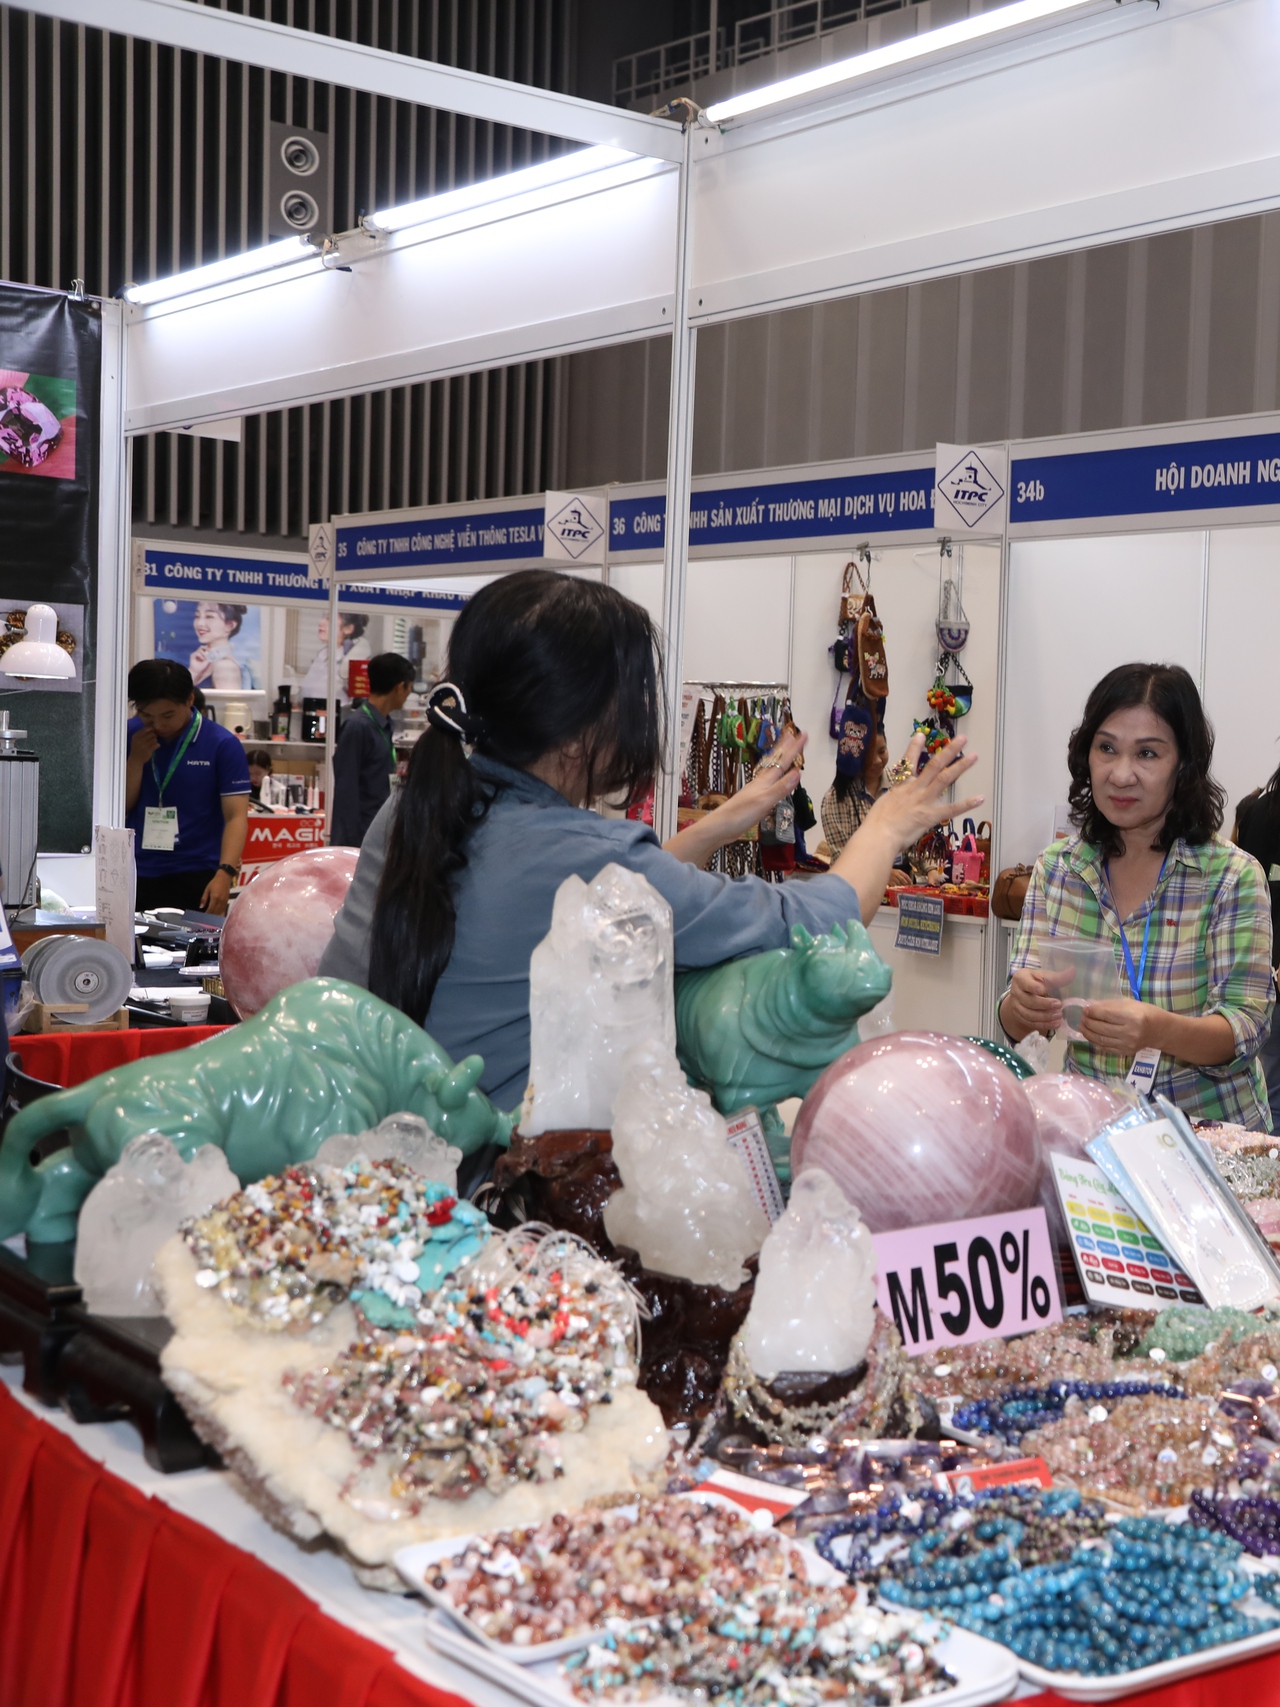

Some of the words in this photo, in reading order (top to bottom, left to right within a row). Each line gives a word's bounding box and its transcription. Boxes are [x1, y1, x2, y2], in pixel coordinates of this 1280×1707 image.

[1016, 480, 1045, 504] 34b
[1155, 462, 1185, 495] HỘI
[1190, 461, 1251, 488] DOANH
[953, 489, 989, 502] ITPC
[612, 517, 626, 536] 36
[633, 511, 661, 534] CÔNG
[689, 510, 708, 530] NHH
[710, 501, 733, 527] SẢN
[735, 497, 764, 526] XUẤT
[768, 498, 815, 523] THƯƠNG
[817, 497, 841, 521] MẠI
[844, 494, 874, 520] DỊCH
[878, 492, 895, 518] VỤ
[899, 489, 926, 512] HOA
[337, 541, 348, 558] 35
[356, 536, 377, 557] CÔNG
[377, 539, 388, 554] TY
[389, 537, 410, 553] TNHH
[411, 532, 433, 552] CÔNG
[433, 529, 456, 552] NGHỆ
[457, 524, 477, 548] VIỄN
[478, 525, 507, 546] THÔNG
[509, 525, 537, 544] TESLA
[560, 528, 591, 540] ITPC
[164, 562, 202, 580] CÔNG
[205, 568, 224, 582] TY
[227, 570, 263, 584] TNHH
[267, 573, 319, 590] THƯƠNG
[874, 1266, 935, 1347] M
[933, 1229, 1051, 1337] 50%
